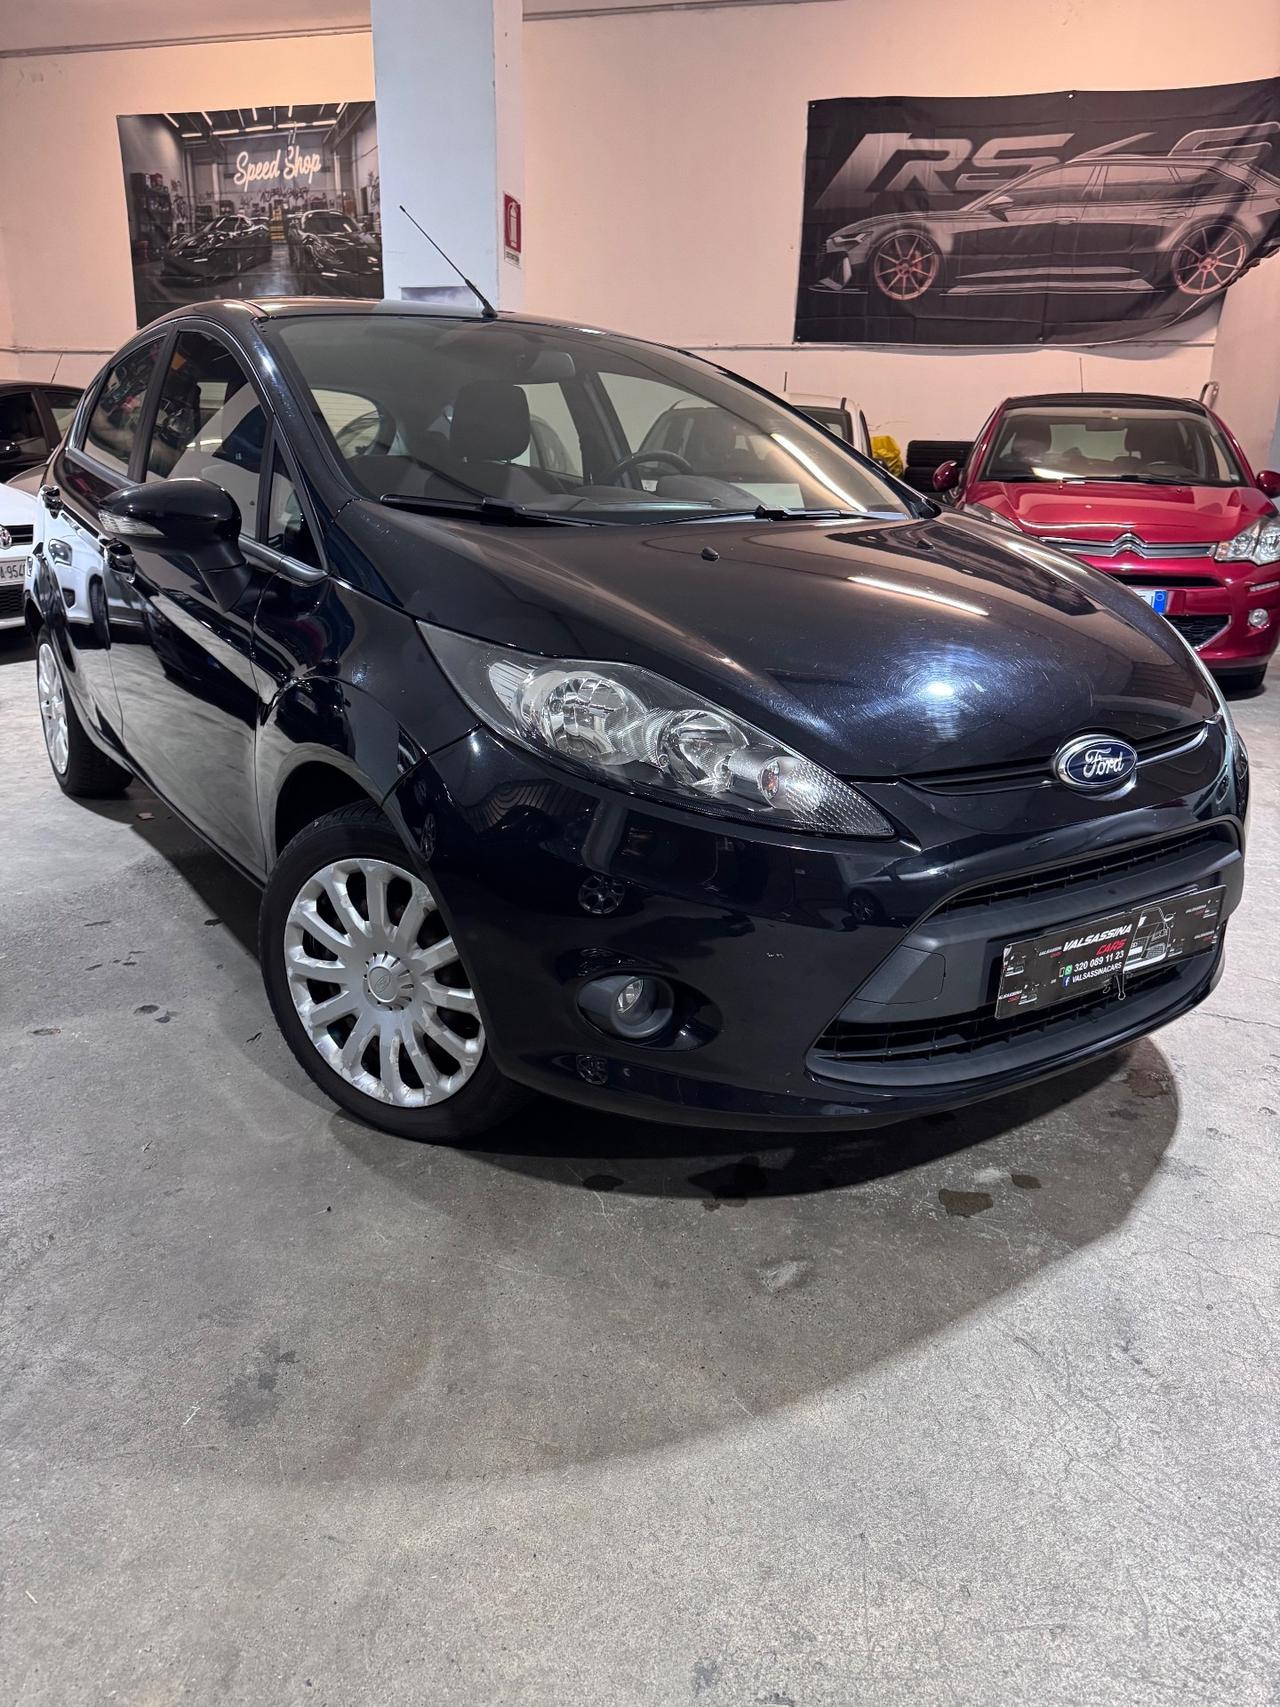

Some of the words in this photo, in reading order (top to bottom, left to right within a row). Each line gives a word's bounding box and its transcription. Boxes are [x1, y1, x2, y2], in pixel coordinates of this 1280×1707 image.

[233, 149, 281, 193] Speed
[283, 145, 322, 184] Shop
[1083, 747, 1124, 777] Ford
[1063, 923, 1132, 952] VALSASSINA
[1096, 938, 1127, 956] CARS
[1072, 962, 1122, 983] VALSASSINACARS
[1073, 960, 1088, 973] 320
[1089, 956, 1104, 968] 089
[1105, 952, 1114, 963] 11
[1115, 949, 1125, 960] 23
